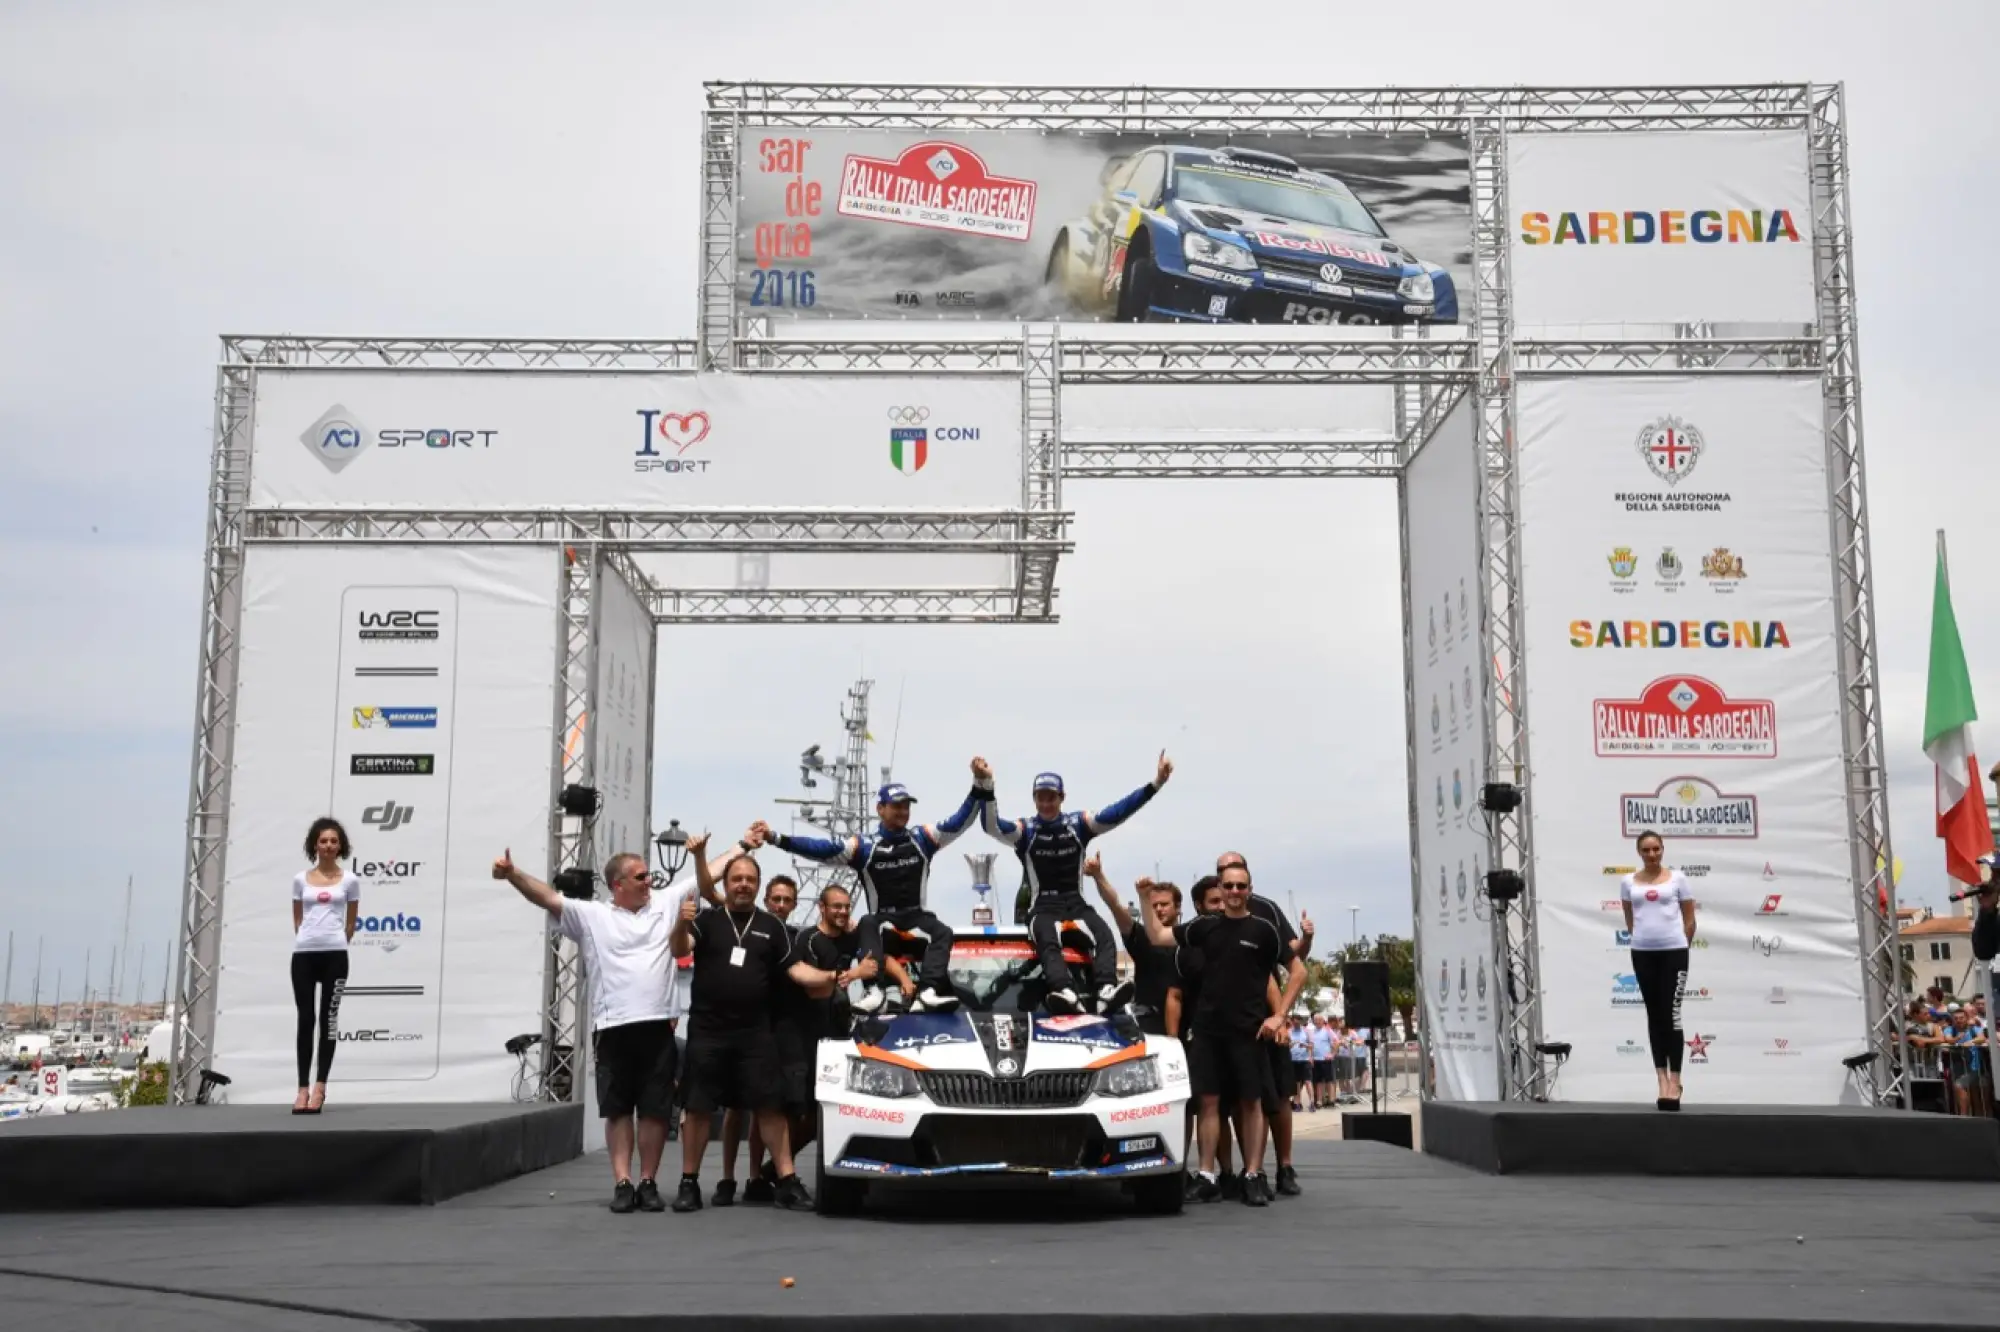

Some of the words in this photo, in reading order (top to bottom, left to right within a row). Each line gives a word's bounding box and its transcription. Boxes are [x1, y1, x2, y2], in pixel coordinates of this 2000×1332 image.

[759, 138, 812, 173] sar
[785, 176, 822, 217] de
[843, 160, 893, 200] RALLY
[894, 176, 943, 208] ITALIA
[947, 185, 1029, 221] SARDEGNA
[1521, 210, 1800, 244] SARDEGNA
[755, 222, 811, 268] gna
[751, 269, 816, 308] 2016
[896, 294, 919, 305] FIA
[321, 430, 360, 447] ACI
[378, 430, 498, 447] SPORT
[635, 410, 660, 456] I
[894, 431, 925, 439] ITALIA
[935, 427, 981, 440] CONI
[634, 460, 711, 473] SPORT
[1614, 493, 1663, 502] REGIONE
[1666, 493, 1731, 502] AUTONOMA
[1626, 503, 1658, 512] DELLA
[1661, 503, 1721, 513] SARDEGNA
[360, 611, 439, 627] WRC
[1569, 620, 1790, 649] SARDEGNA
[1599, 703, 1641, 739] RALLY
[1644, 712, 1690, 739] ITALIA
[1693, 705, 1772, 740] SARDEGNA
[355, 758, 415, 766] CERTINA
[1627, 800, 1658, 824] RALLY
[1660, 807, 1693, 824] DELLA
[1696, 800, 1752, 824] SARDEGNA
[838, 1103, 905, 1124] KONECRANES
[1110, 1103, 1170, 1123] KONECRANES
